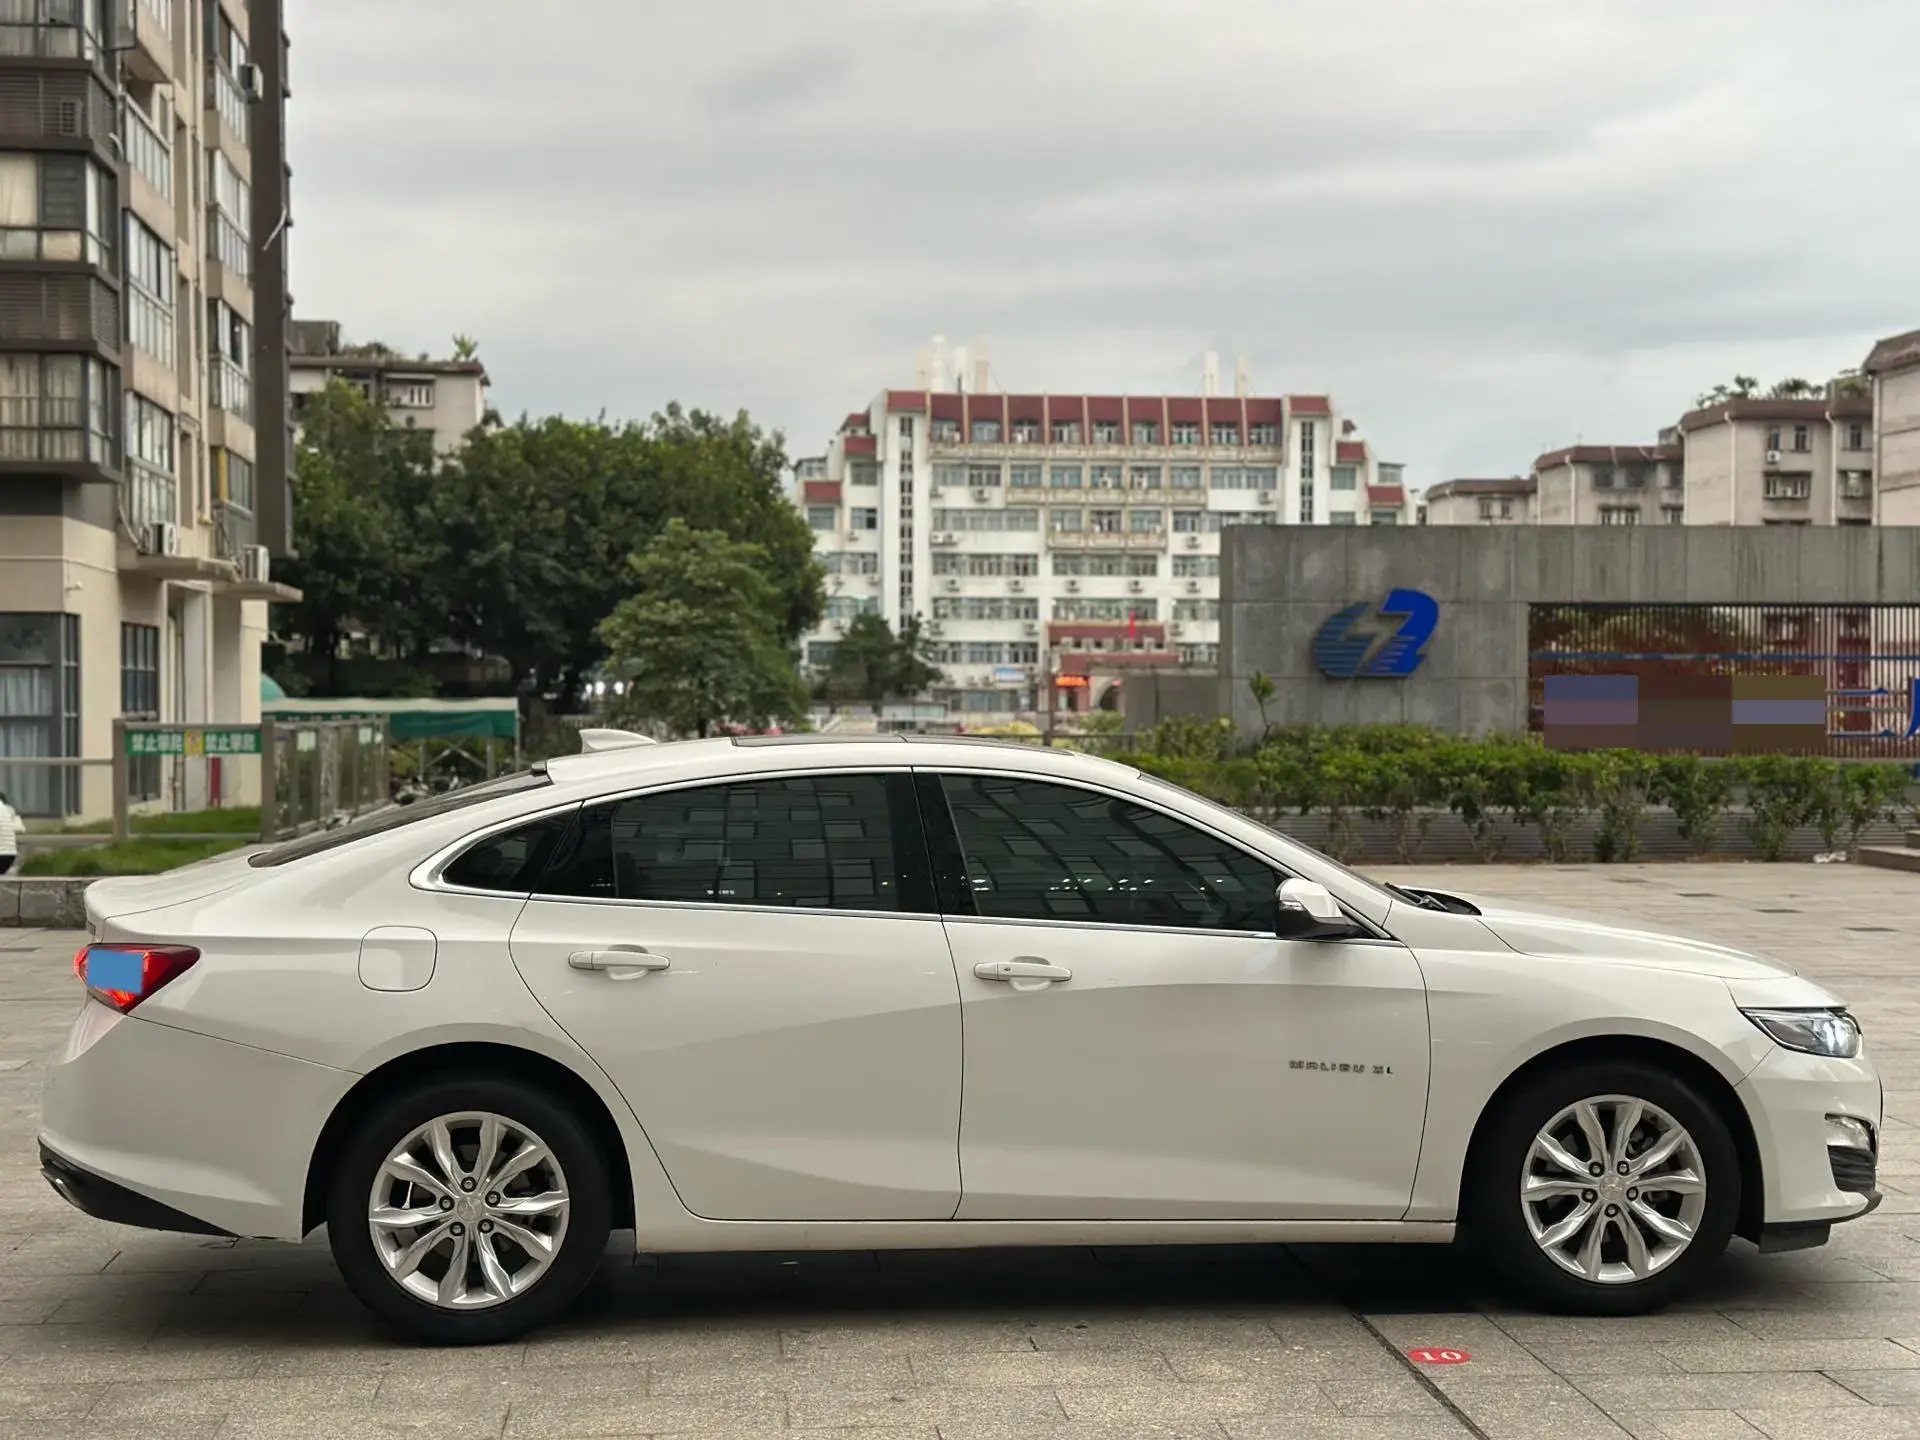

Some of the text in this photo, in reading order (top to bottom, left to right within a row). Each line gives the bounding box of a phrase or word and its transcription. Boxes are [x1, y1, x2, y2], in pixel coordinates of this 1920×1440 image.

[1289, 1060, 1393, 1074] MALIBU XL
[1417, 1351, 1462, 1360] 10
